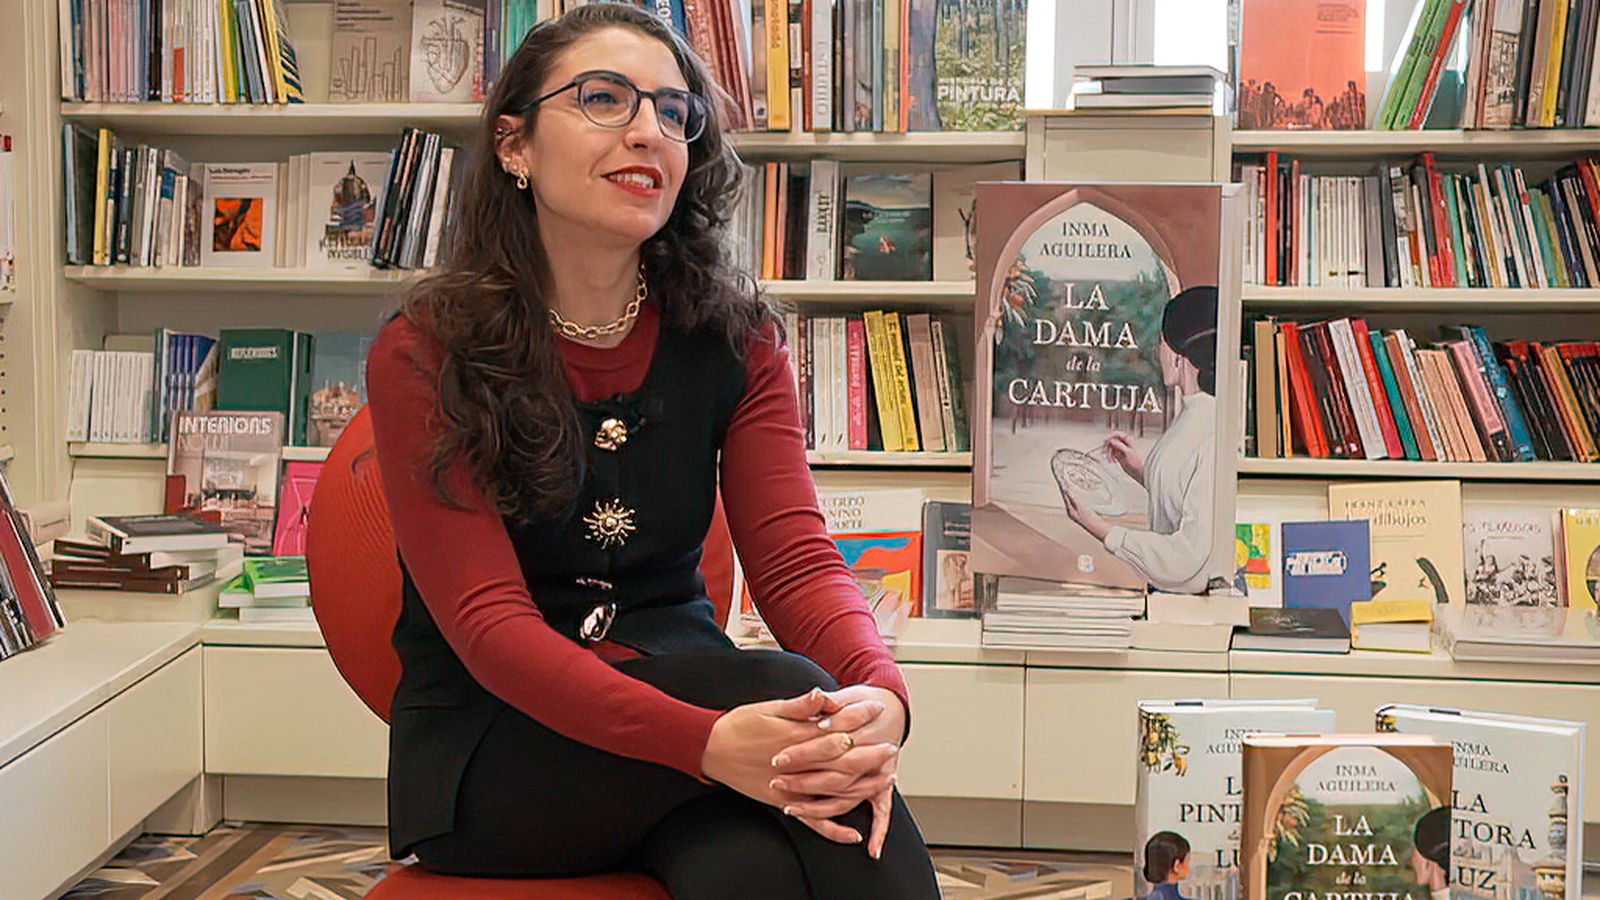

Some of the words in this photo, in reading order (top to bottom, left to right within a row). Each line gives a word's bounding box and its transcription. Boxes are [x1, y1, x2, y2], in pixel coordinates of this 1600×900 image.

[937, 86, 1022, 102] PINTURA
[1062, 222, 1109, 237] INMA
[1040, 243, 1131, 259] AGUILERA
[1063, 283, 1110, 310] LA
[1033, 319, 1139, 349] DAMA
[1066, 355, 1083, 371] de
[1086, 356, 1102, 372] la
[1008, 378, 1163, 413] CARTUJA
[178, 416, 273, 435] INTERIORS
[1373, 512, 1426, 527] dibujos
[1336, 765, 1377, 776] INMA
[1226, 776, 1242, 796] L
[1316, 781, 1396, 792] AGUILERA
[1452, 790, 1488, 814] LA
[1180, 803, 1241, 823] PINT
[1334, 815, 1373, 836] LA
[1453, 819, 1536, 849] TORA
[1216, 849, 1240, 869] LU
[1307, 844, 1398, 865] DAMA
[1335, 871, 1351, 884] de
[1450, 866, 1497, 890] UZ
